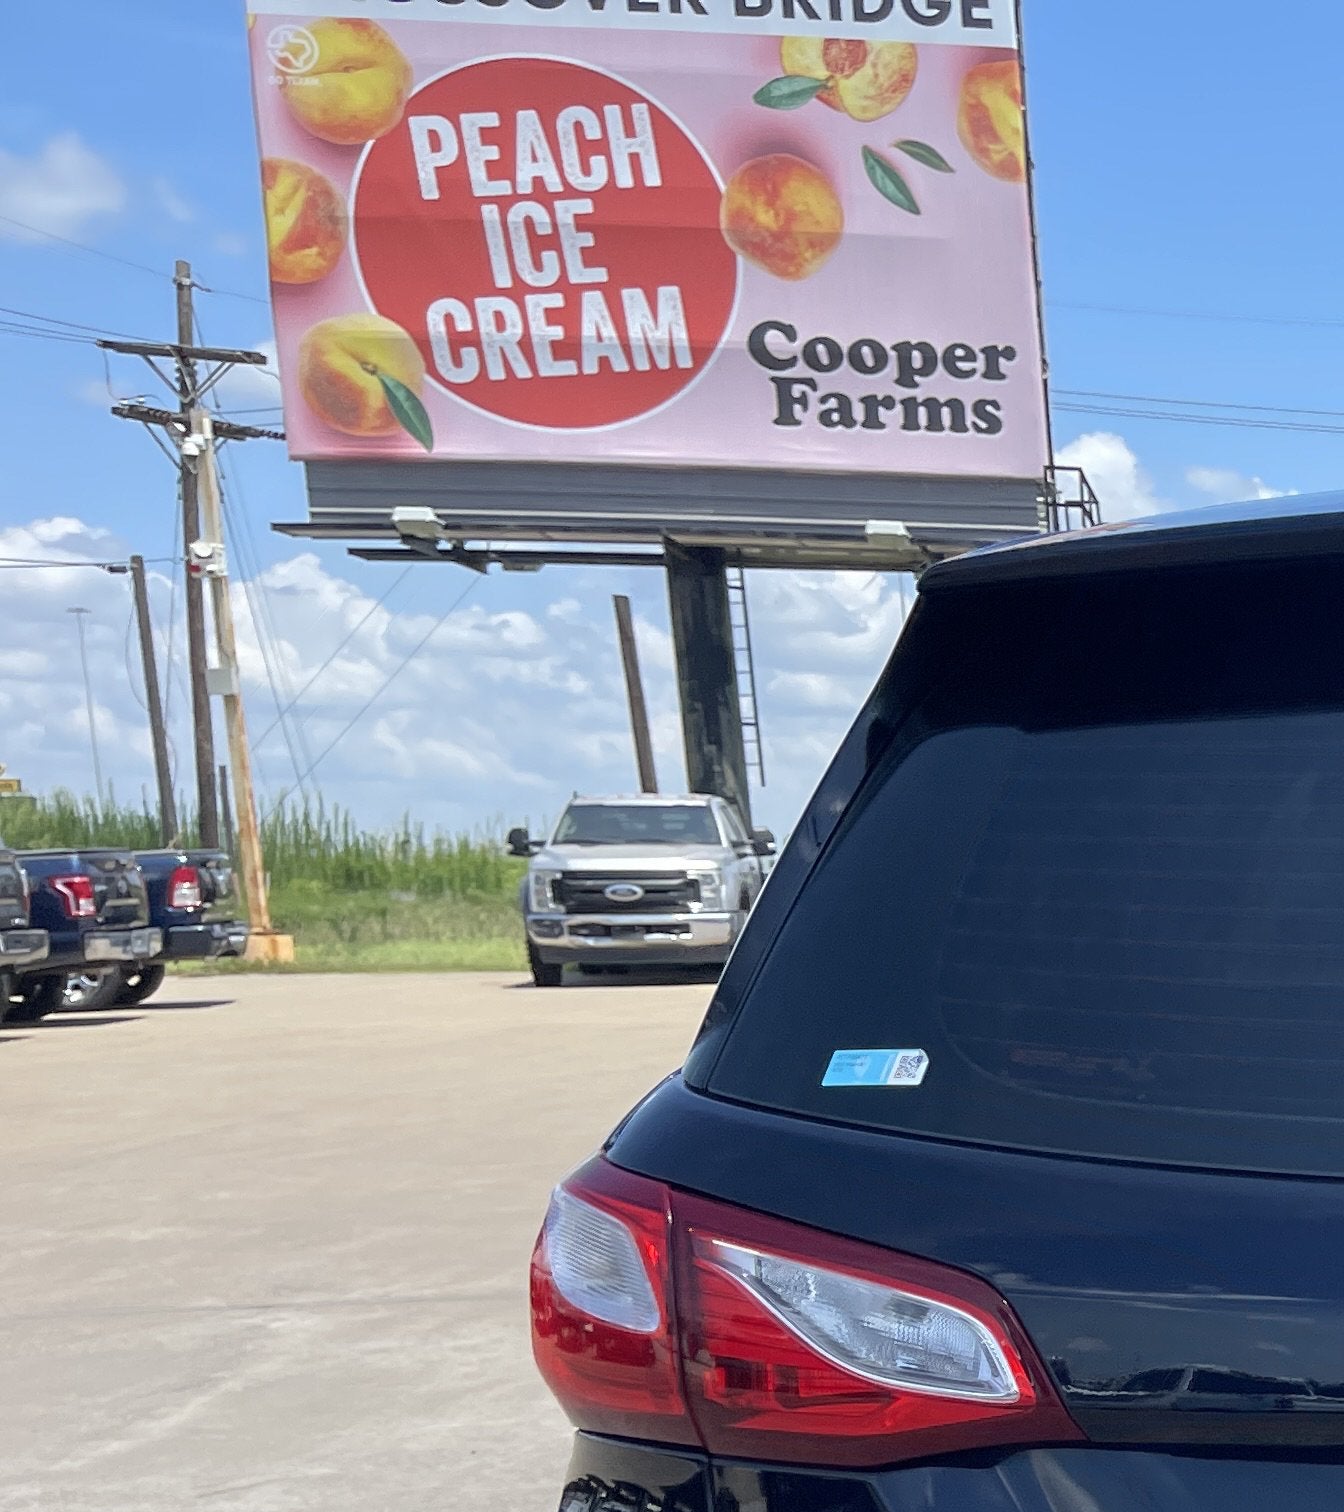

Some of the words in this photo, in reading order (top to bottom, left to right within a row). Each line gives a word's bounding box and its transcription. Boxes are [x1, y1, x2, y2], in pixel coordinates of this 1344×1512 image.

[408, 103, 662, 200] PEACH
[480, 198, 609, 289] ICE
[426, 285, 693, 384] CREAM
[747, 320, 1017, 389] Cooper
[770, 376, 1003, 435] Farms
